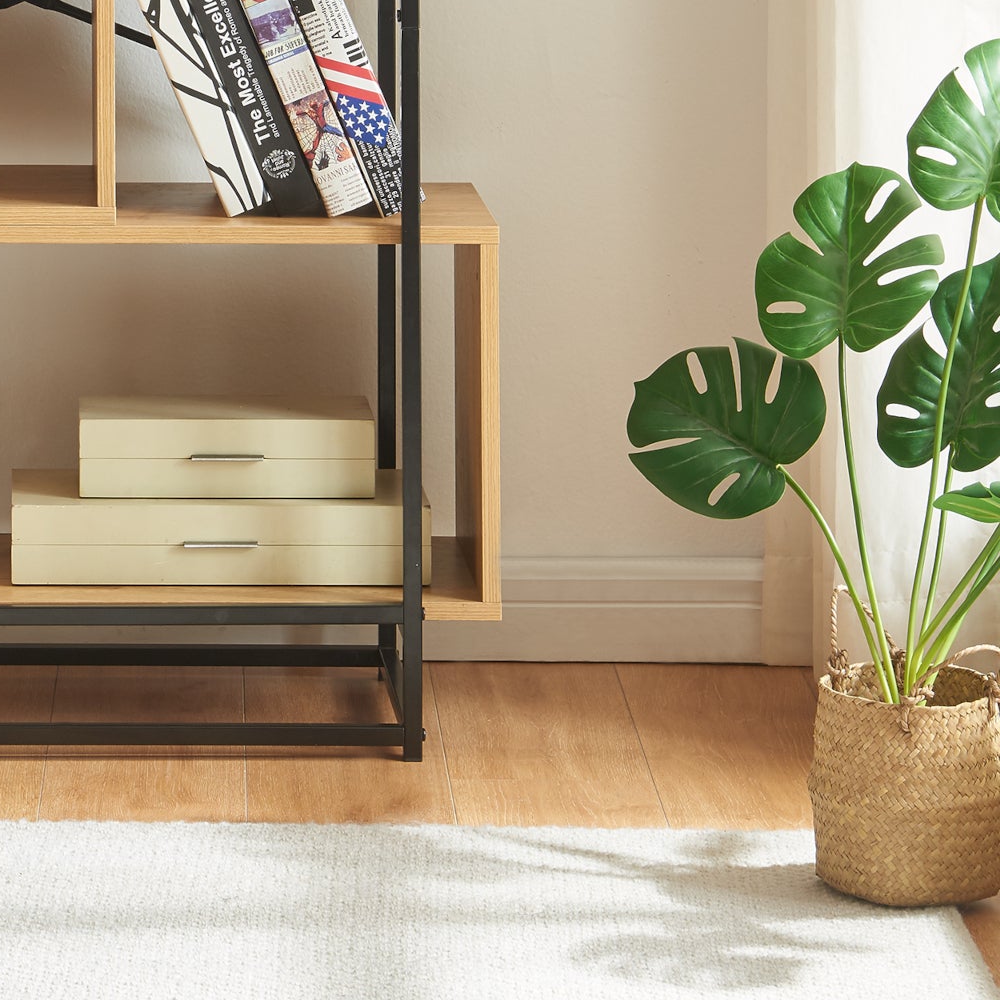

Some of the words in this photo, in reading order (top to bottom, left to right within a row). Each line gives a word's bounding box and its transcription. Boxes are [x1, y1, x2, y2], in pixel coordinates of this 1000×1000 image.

[221, 7, 238, 35] Romeo
[330, 29, 342, 41] A
[232, 35, 242, 45] of
[236, 44, 257, 77] Tragedy
[226, 59, 256, 106] Most
[249, 77, 273, 122] Lamentable
[245, 107, 272, 144] The
[267, 122, 280, 138] and
